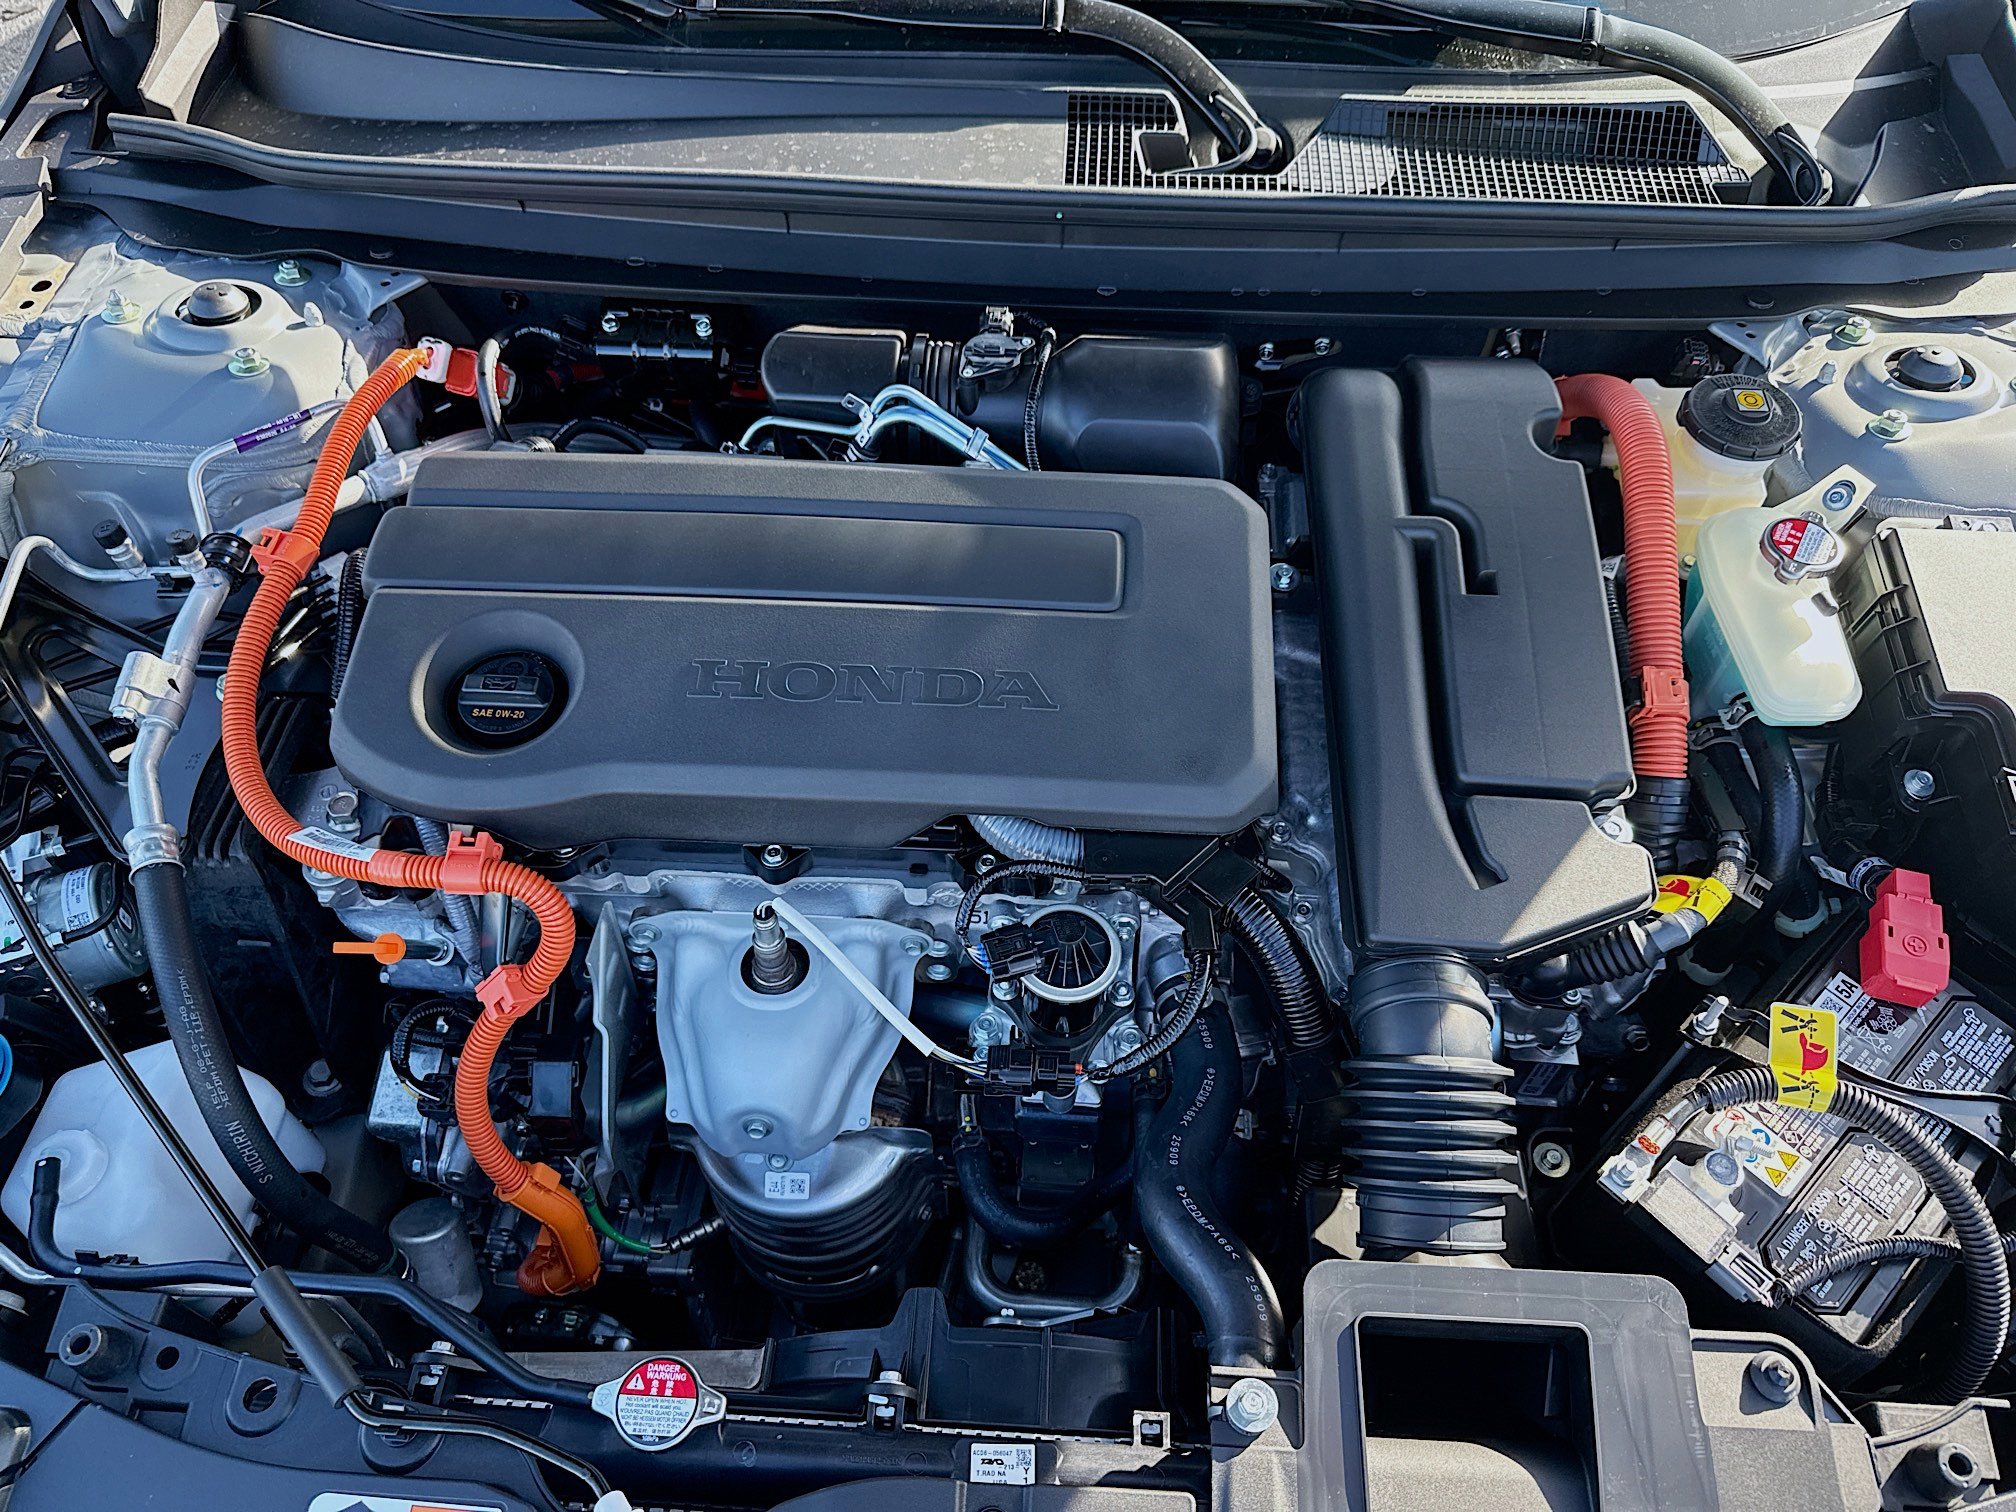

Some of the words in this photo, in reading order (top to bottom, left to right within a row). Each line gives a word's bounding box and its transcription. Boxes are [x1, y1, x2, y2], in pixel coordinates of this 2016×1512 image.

[686, 658, 1059, 711] HONDA
[472, 708, 494, 717] SAE
[495, 709, 526, 719] 0W-20
[1837, 979, 1858, 1001] 5A
[1196, 1017, 1213, 1049] 25909
[1880, 1042, 1893, 1055] Pb
[1169, 1134, 1182, 1165] 25909
[1245, 1275, 1268, 1321] 25909
[647, 1363, 681, 1373] DANGER
[646, 1371, 687, 1381] WARNUNG
[997, 1469, 1007, 1477] NA
[1023, 1466, 1030, 1475] Y
